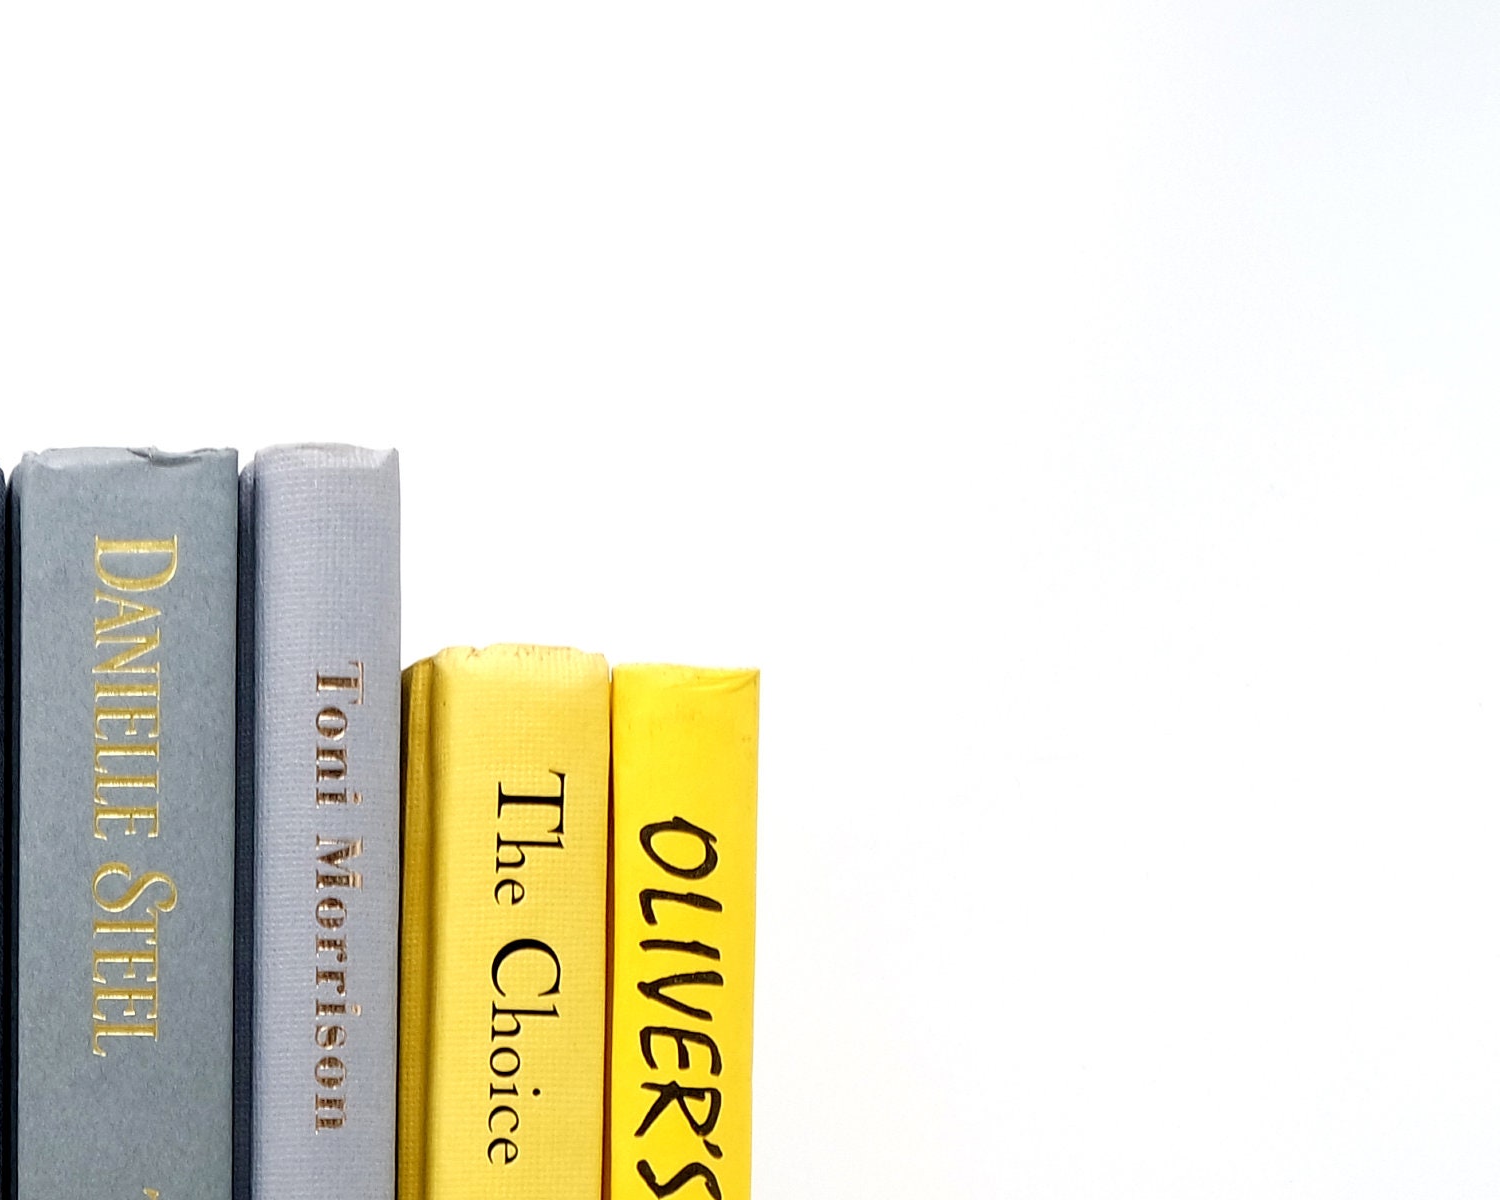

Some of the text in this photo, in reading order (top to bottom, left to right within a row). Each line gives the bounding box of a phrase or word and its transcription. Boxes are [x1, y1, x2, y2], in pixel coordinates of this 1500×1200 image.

[92, 535, 179, 1057] DANIELLE STEEL
[313, 661, 364, 1135] Toni Morrison
[487, 768, 567, 1166] The Choice
